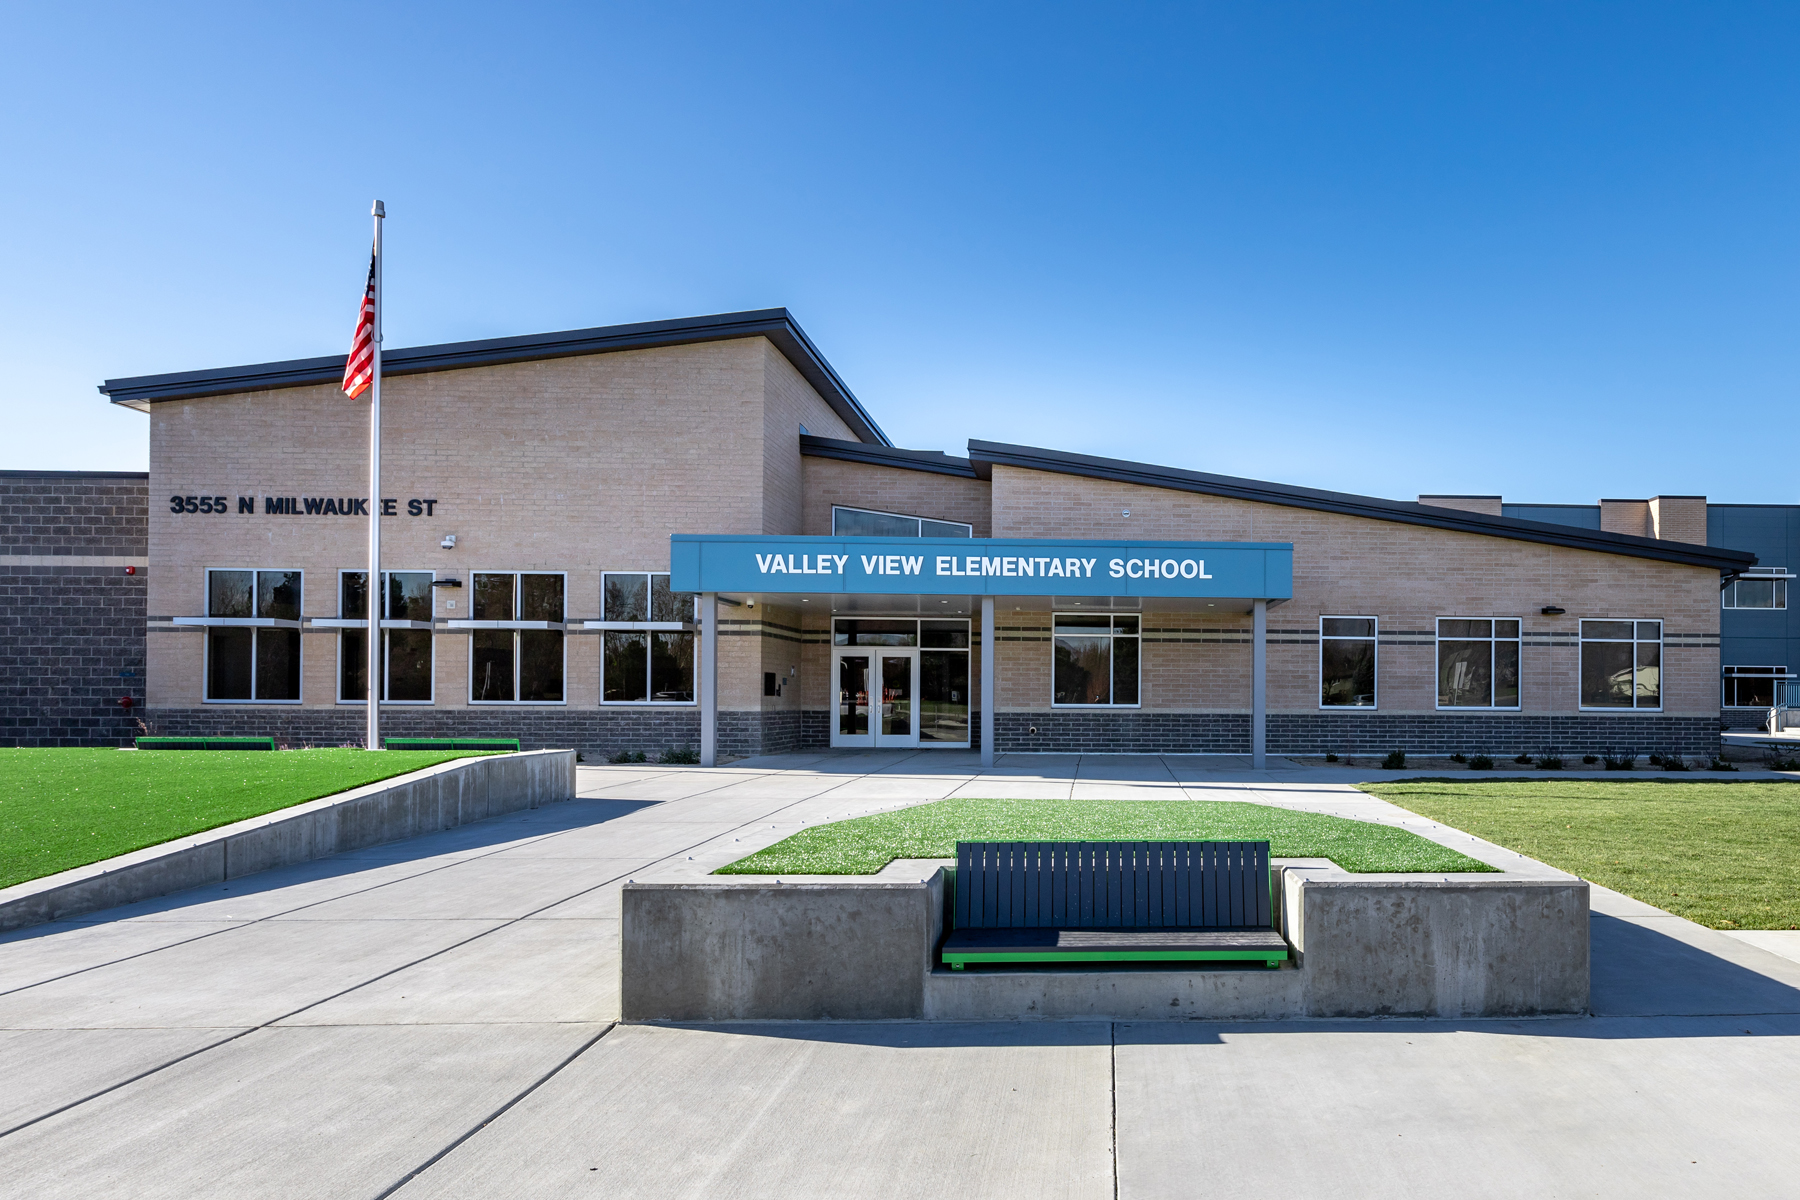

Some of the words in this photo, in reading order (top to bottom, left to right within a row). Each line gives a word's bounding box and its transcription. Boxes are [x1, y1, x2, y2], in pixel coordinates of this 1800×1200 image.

[169, 495, 228, 515] 3555
[238, 496, 255, 515] N
[265, 497, 398, 517] MILWAUKE
[407, 498, 438, 517] ST
[755, 553, 849, 575] VALLEY
[860, 554, 924, 576] VIEW
[935, 555, 1097, 578] ELEMENTARY
[1108, 557, 1213, 580] SCHOOL
